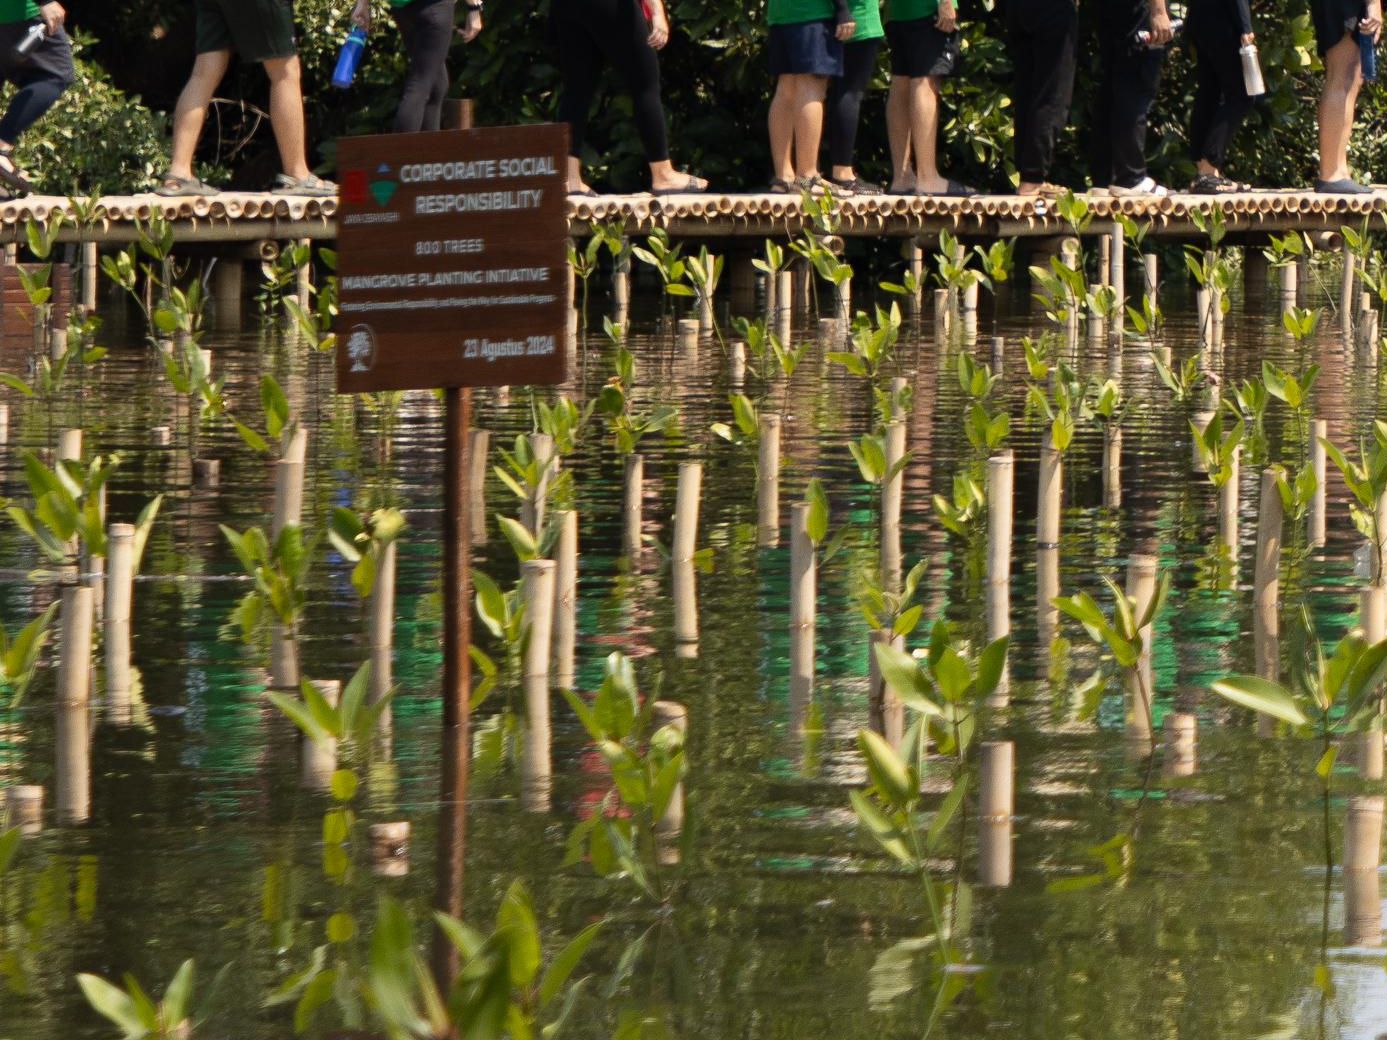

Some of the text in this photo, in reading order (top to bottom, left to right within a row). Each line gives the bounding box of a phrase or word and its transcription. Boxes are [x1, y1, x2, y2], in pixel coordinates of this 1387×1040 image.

[400, 157, 557, 182] CORPORATE SOCIAL
[415, 190, 542, 213] RESPONSIBILITY
[415, 239, 483, 255] 800 TREES
[342, 274, 416, 289] MANGROVE
[418, 270, 483, 287] PLANTING
[480, 337, 525, 362] Agustus
[526, 336, 554, 354] 2024
